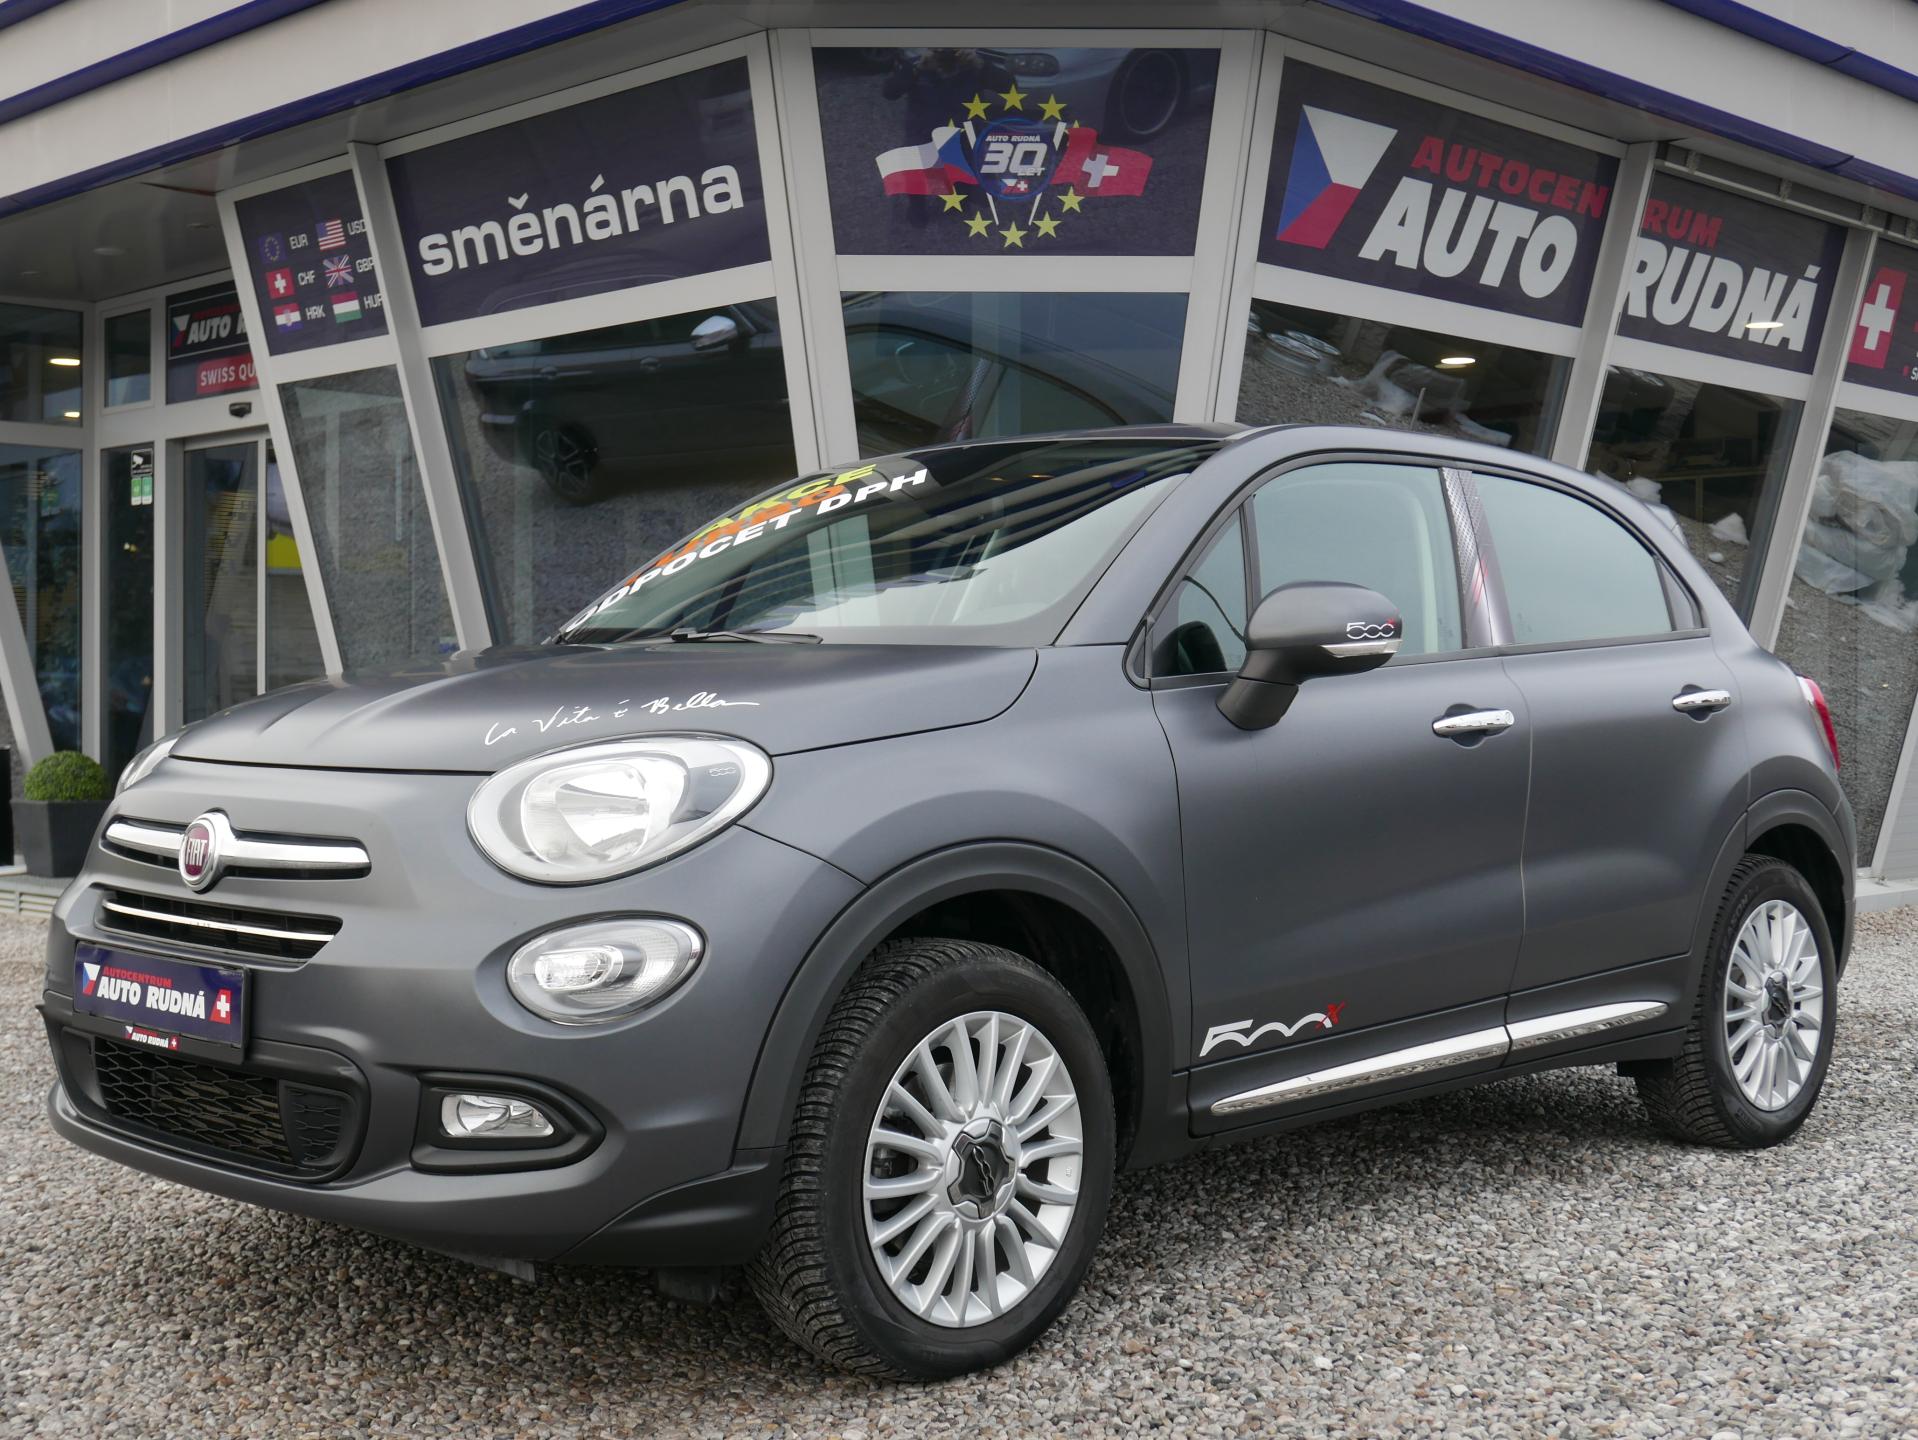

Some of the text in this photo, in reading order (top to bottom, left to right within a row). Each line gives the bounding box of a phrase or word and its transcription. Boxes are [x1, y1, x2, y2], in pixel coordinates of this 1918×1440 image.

[980, 142, 1048, 174] 30
[418, 163, 745, 277] směnárna
[289, 233, 309, 250] EUR
[297, 270, 316, 286] CHF
[1357, 175, 1823, 352] AUTO RUDNÁ
[305, 305, 326, 321] HRK
[186, 314, 232, 345] AUTO
[200, 365, 236, 387] SWISS
[688, 463, 878, 543] AKCE
[816, 468, 928, 516] DPH
[485, 722, 517, 746] La
[531, 704, 600, 733] Vita
[640, 691, 761, 716] Bella
[185, 837, 208, 867] FIAT
[103, 966, 173, 988] AUTOCENTRUM
[97, 976, 206, 1020] AUTO RUDNÁ
[131, 1032, 148, 1043] AUTO
[147, 1035, 169, 1049] RUDNÁ
